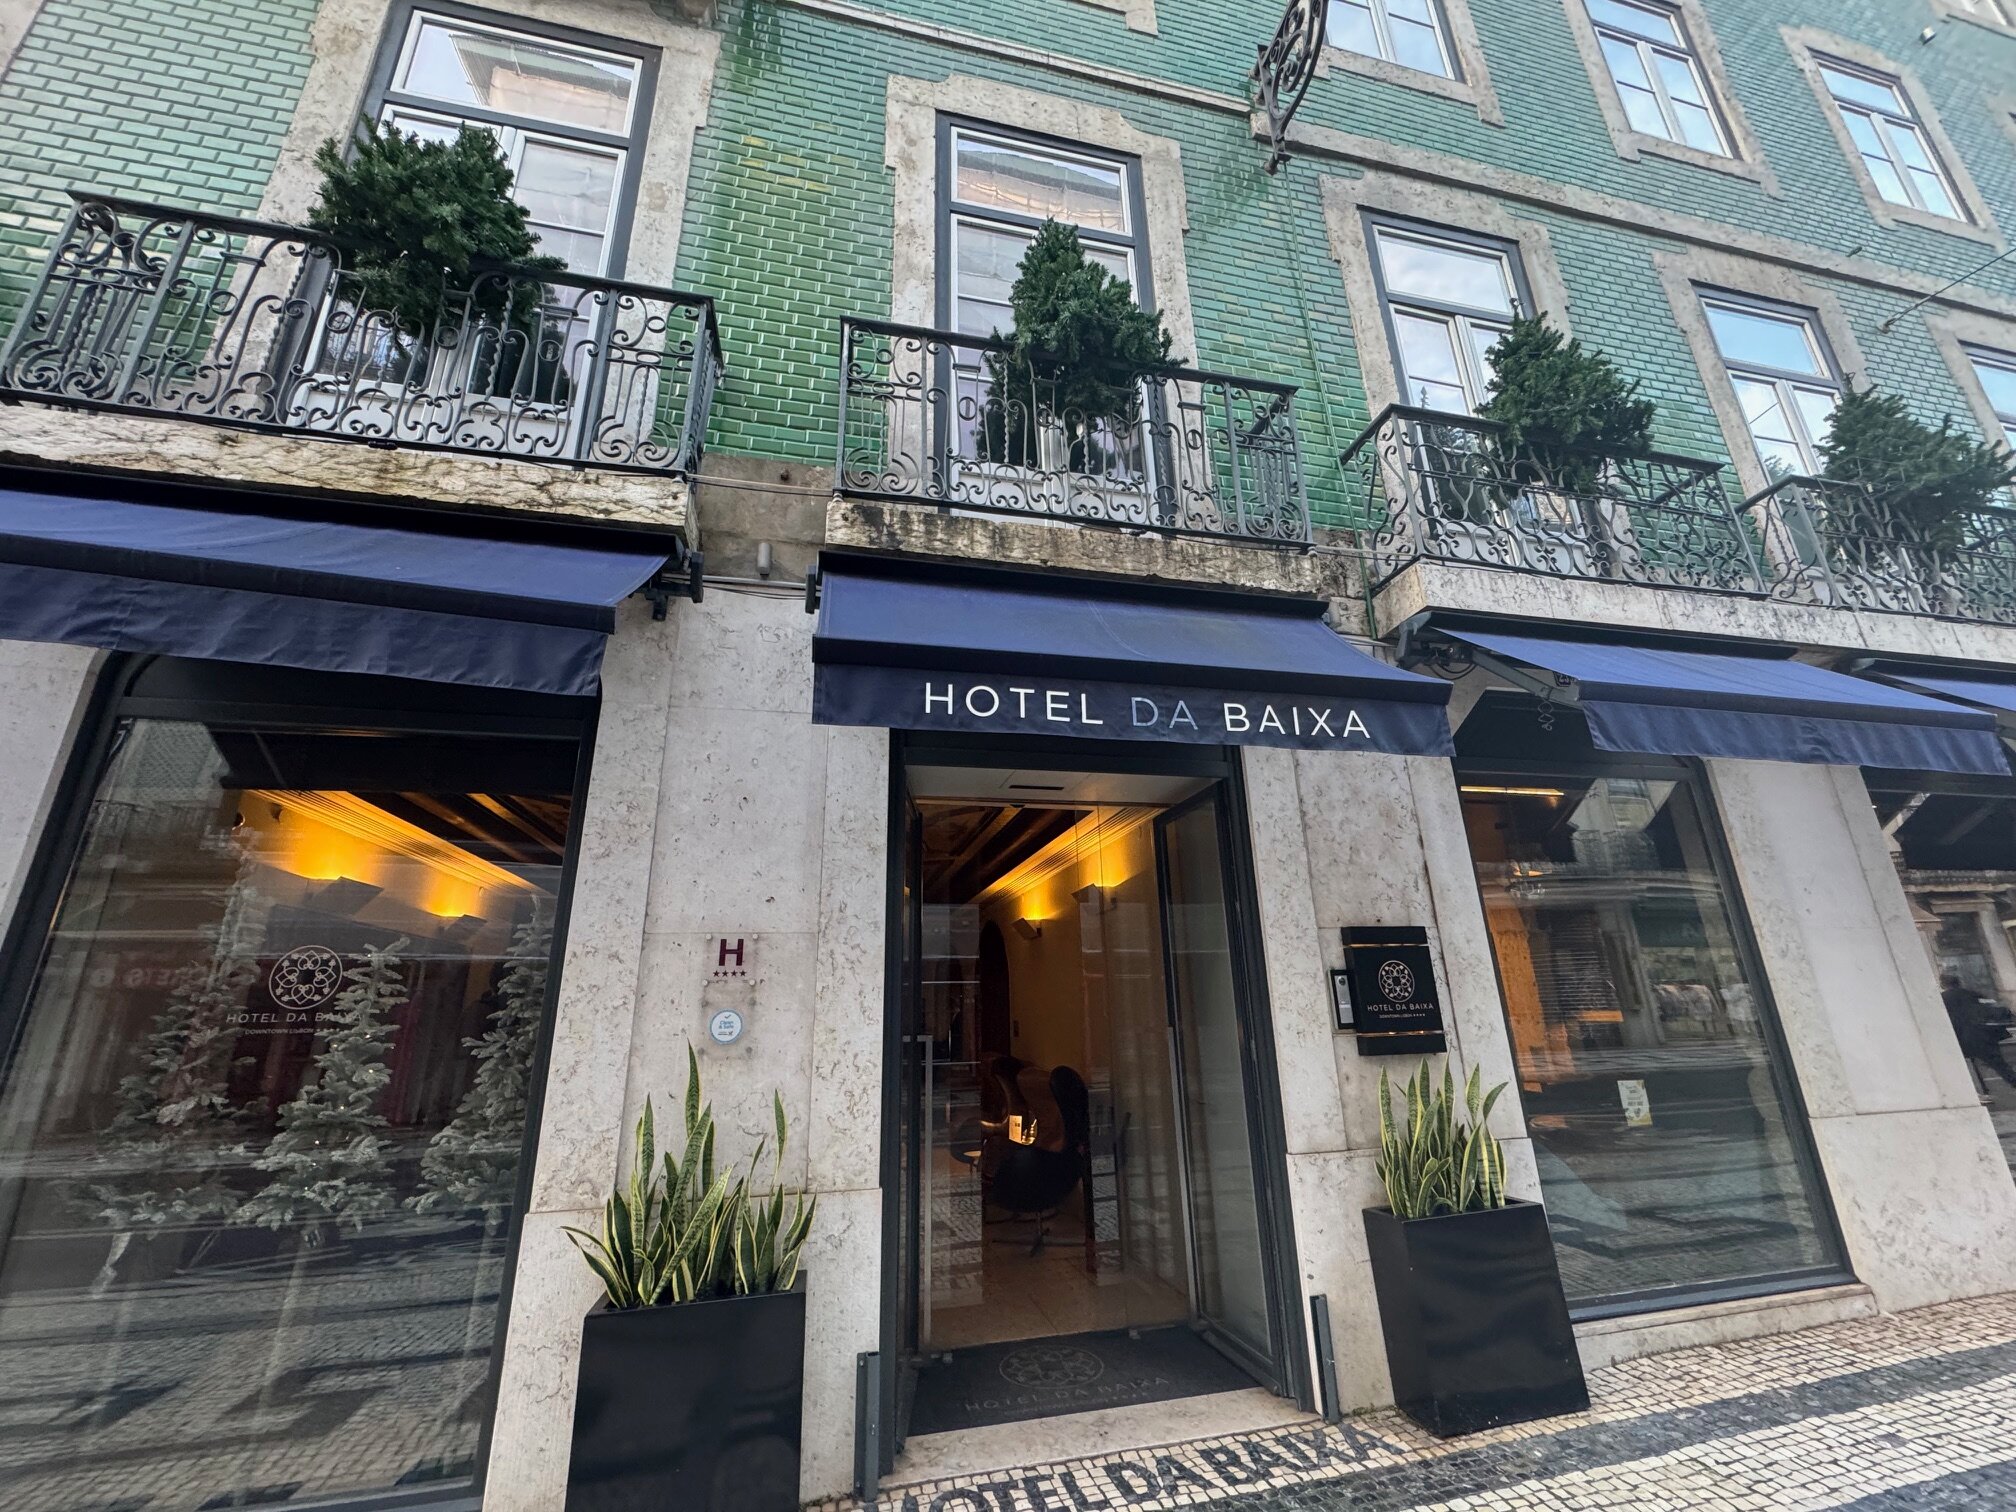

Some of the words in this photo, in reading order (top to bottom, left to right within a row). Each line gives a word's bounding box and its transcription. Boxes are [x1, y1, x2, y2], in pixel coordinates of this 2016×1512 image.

[924, 682, 1104, 726] HOTEL
[1131, 696, 1199, 731] DA
[1223, 701, 1371, 739] BAIXA
[718, 939, 744, 967] H
[226, 1012, 279, 1023] HOTEL
[286, 1012, 307, 1023] DA
[1367, 1004, 1393, 1012] HOTEL
[1395, 1003, 1407, 1011] DA
[1409, 1003, 1434, 1011] BAIXA
[1102, 1455, 1222, 1502] DA
[1200, 1423, 1409, 1486] BAIXA
